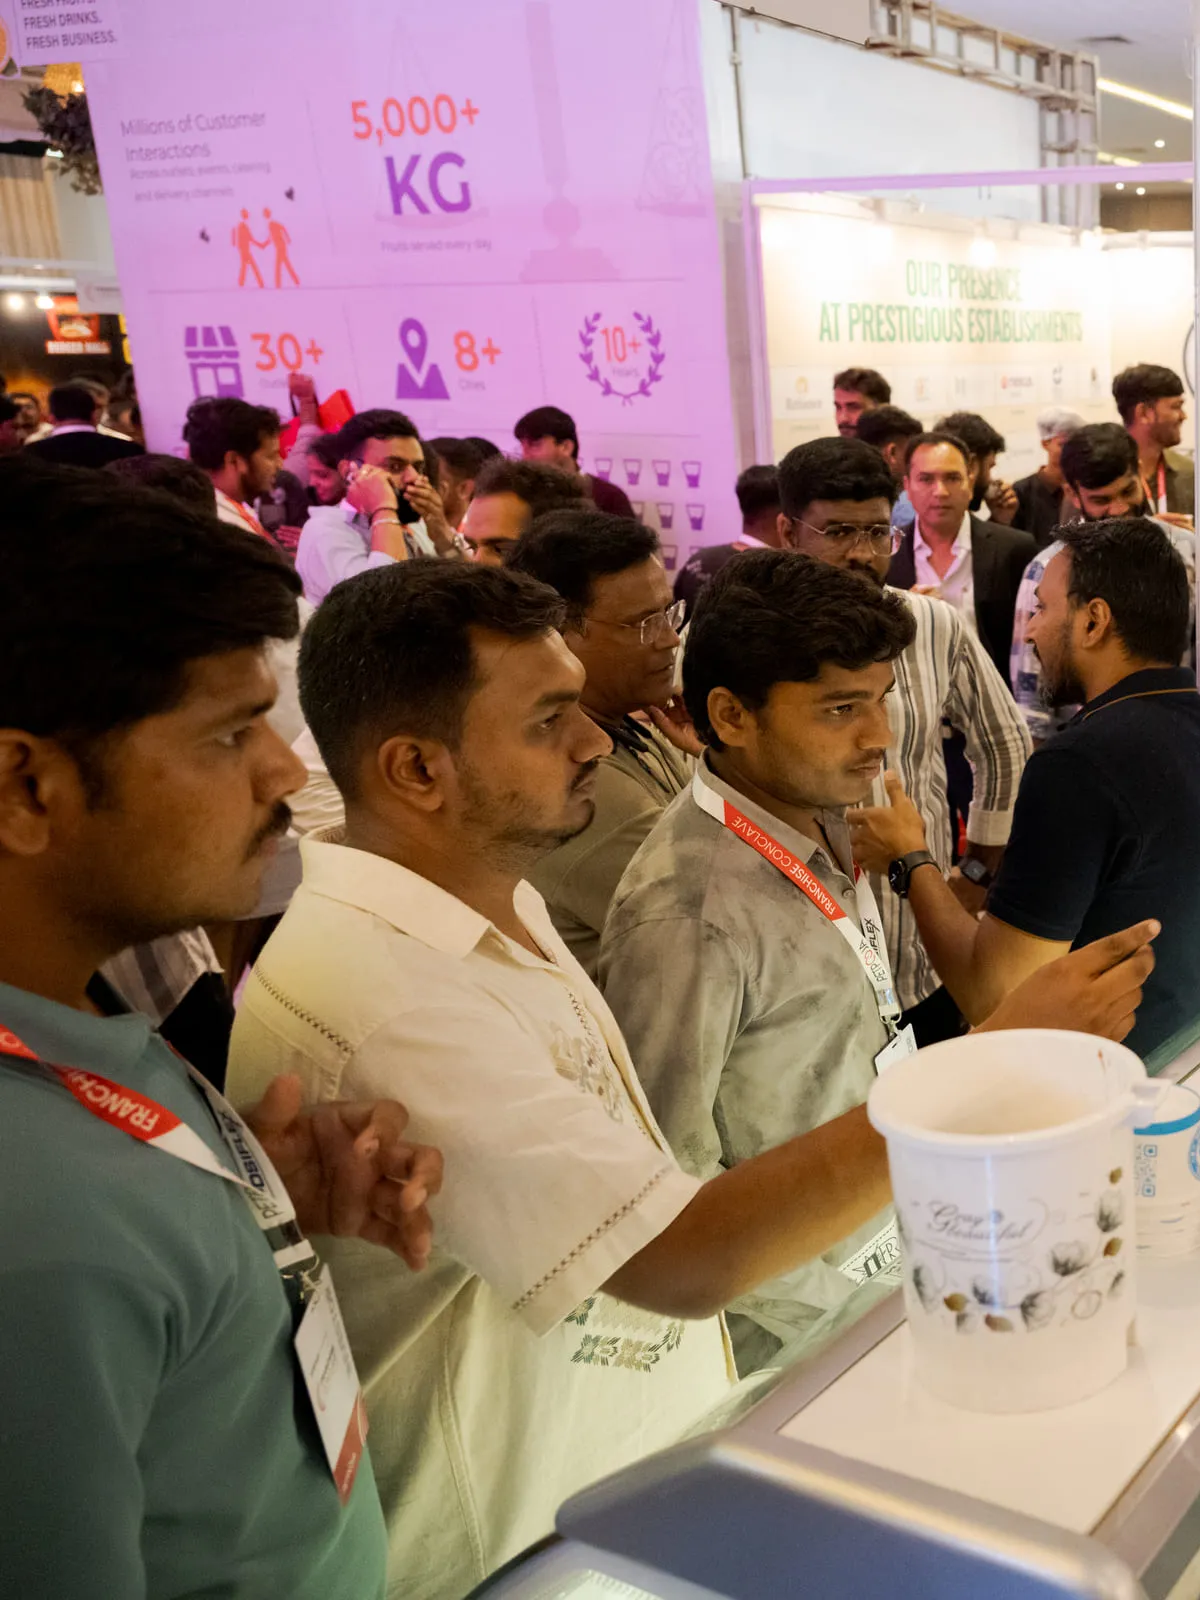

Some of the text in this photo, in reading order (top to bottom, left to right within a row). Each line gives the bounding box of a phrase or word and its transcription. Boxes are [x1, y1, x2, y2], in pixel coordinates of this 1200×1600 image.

[24, 10, 103, 30] FRESH DRINKS.
[26, 35, 60, 50] FRESH
[351, 93, 479, 147] 5,000+
[125, 142, 211, 162] Interactions
[384, 151, 472, 215] KG
[906, 259, 1023, 301] OUR PRESENCE
[819, 303, 1083, 343] AT PRESTIGIOUS ESTABLISHMENTS
[251, 333, 324, 371] 30+
[454, 331, 502, 372] 8+
[601, 326, 642, 363] 10+
[732, 816, 836, 915] FRANCHISE CONCLAVE
